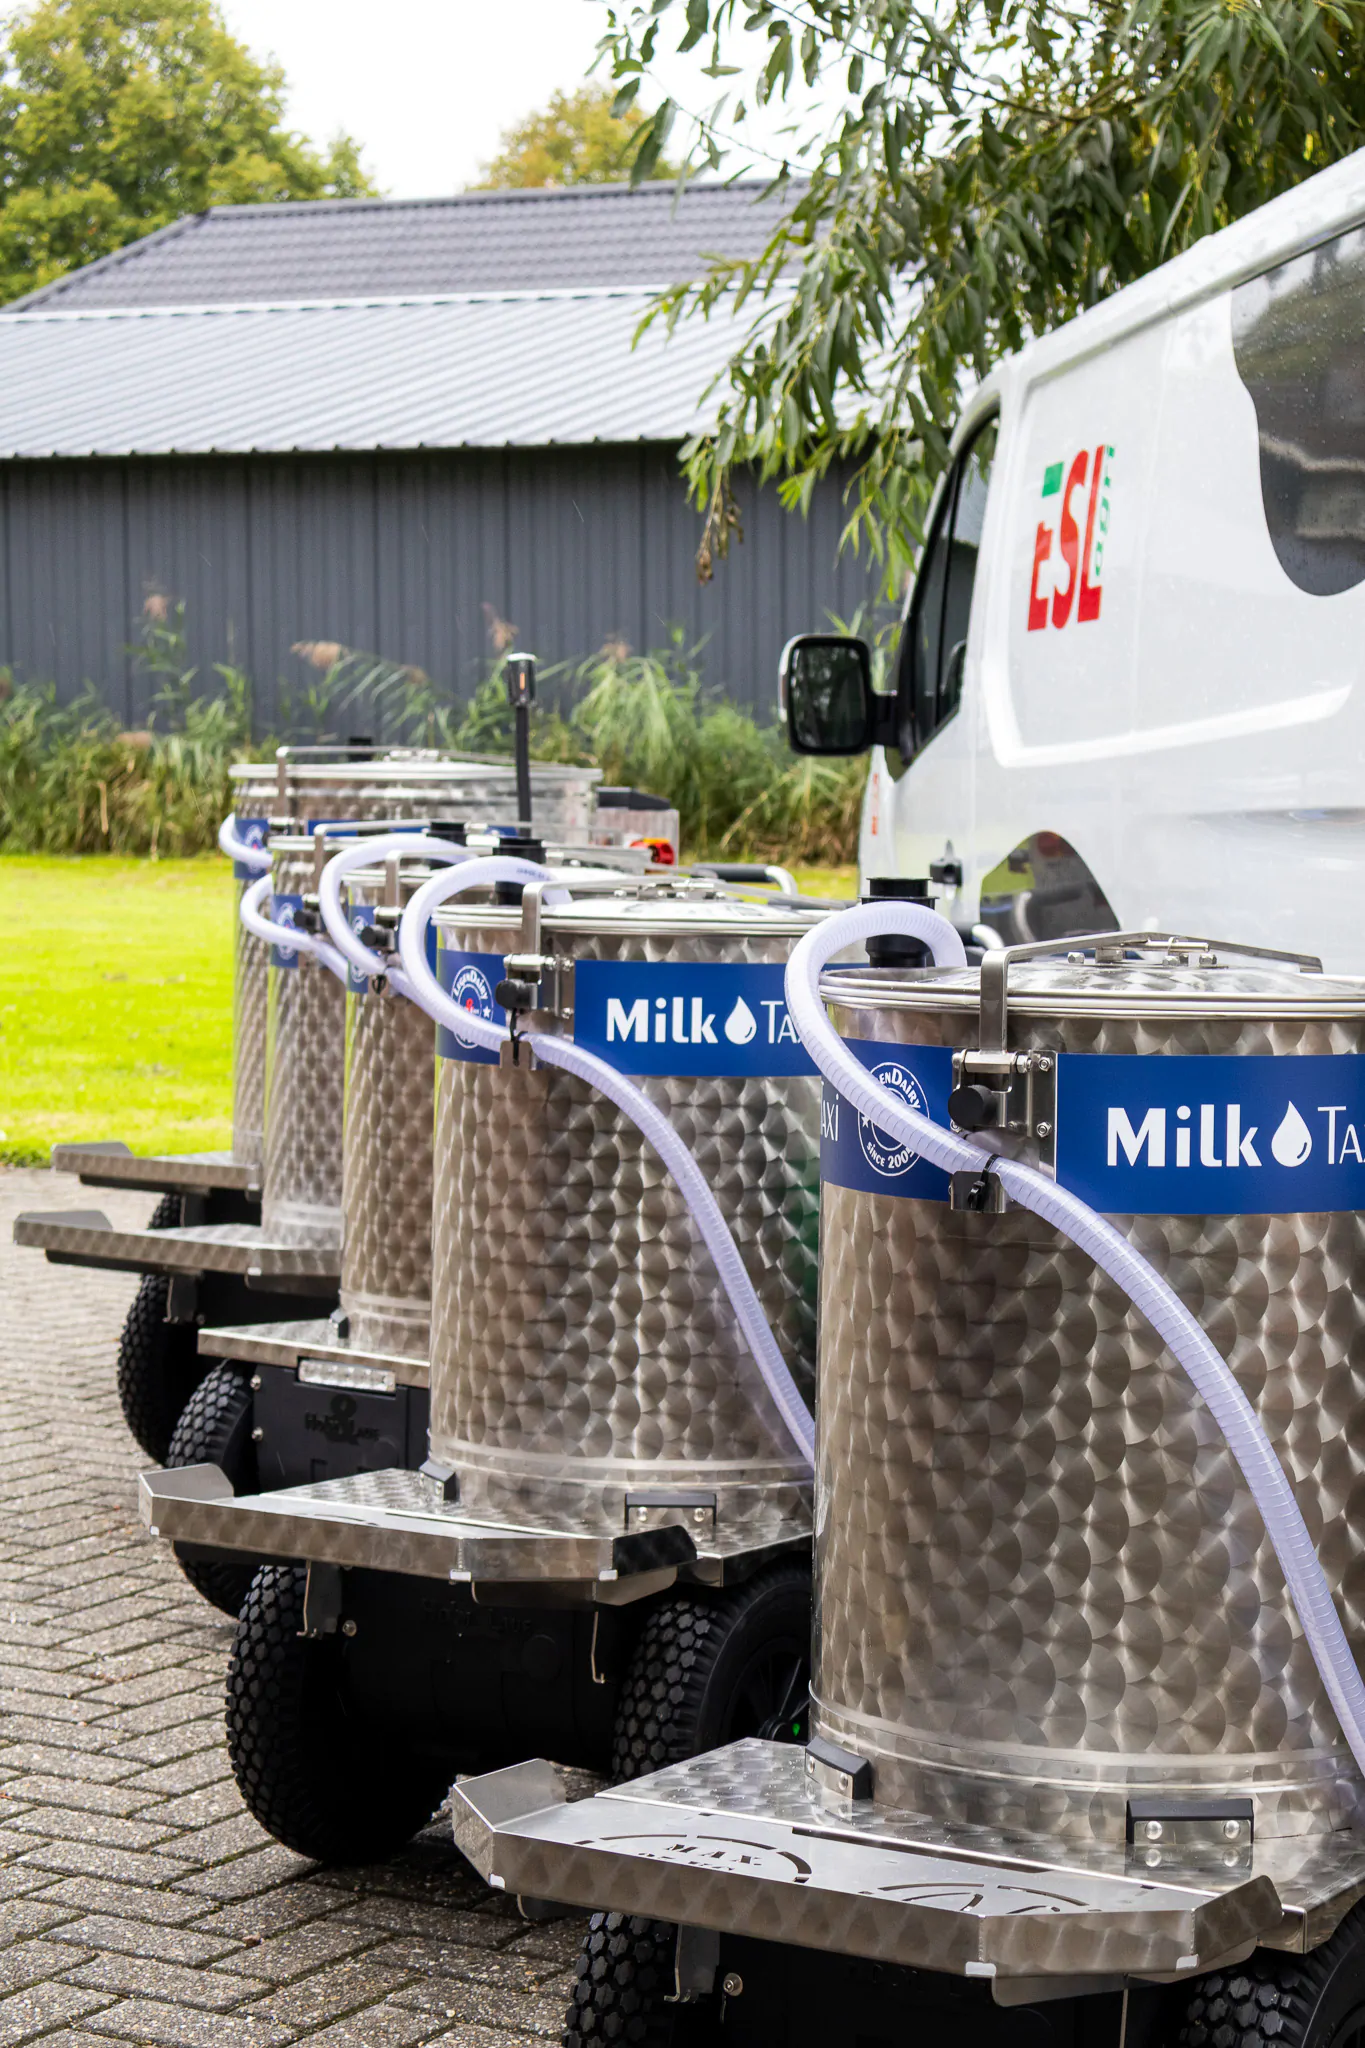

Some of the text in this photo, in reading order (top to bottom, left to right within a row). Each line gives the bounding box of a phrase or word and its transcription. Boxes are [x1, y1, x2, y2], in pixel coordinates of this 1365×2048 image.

[606, 996, 801, 1044] Milk TA
[1107, 1103, 1365, 1168] Milk TA
